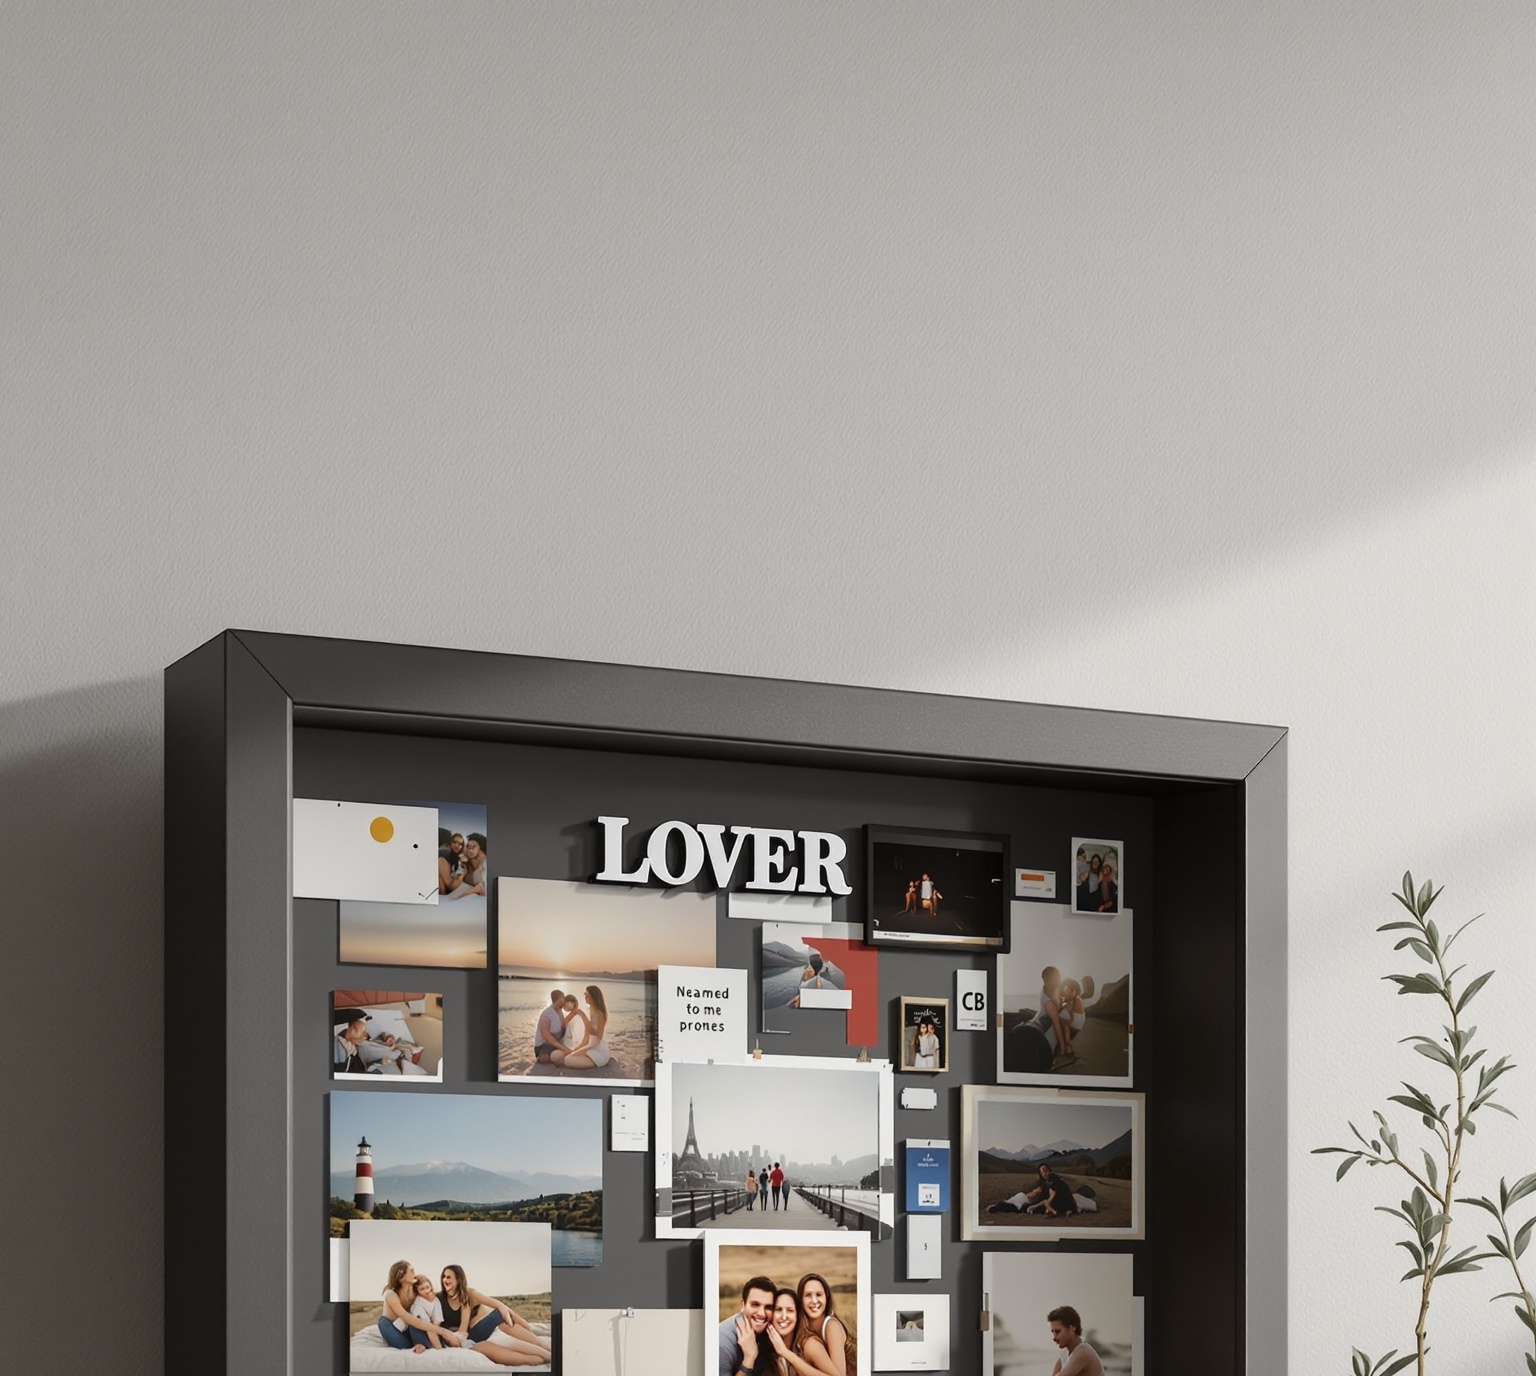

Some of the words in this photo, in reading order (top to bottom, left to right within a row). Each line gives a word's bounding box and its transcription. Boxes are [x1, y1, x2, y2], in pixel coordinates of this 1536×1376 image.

[595, 815, 853, 895] LOVER
[676, 985, 729, 999] Neamed
[962, 991, 985, 1011] CB
[686, 1003, 700, 1015] to
[703, 1006, 722, 1016] me
[679, 1021, 725, 1033] prones
